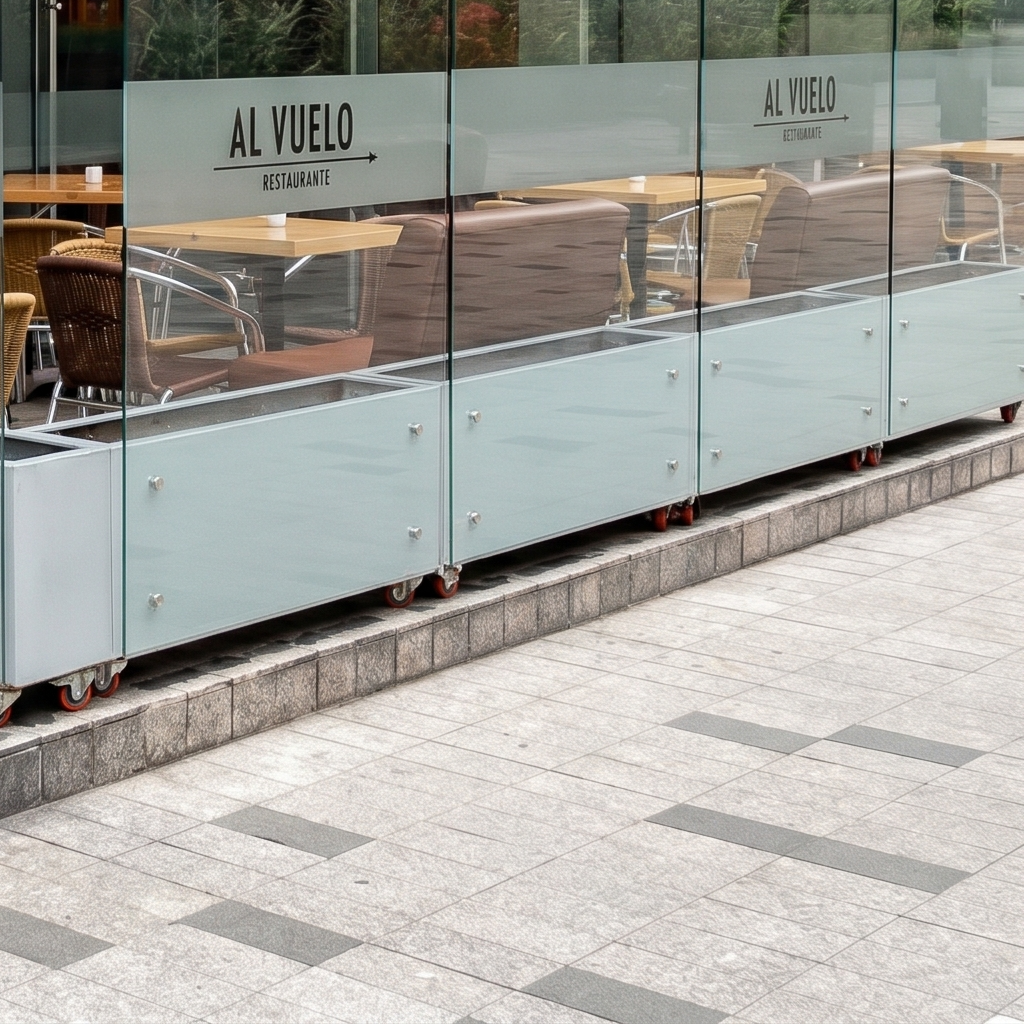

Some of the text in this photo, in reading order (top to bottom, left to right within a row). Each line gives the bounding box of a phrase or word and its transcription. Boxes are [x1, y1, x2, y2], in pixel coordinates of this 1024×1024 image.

[763, 75, 836, 117] AL VUELO
[229, 102, 353, 158] AL VUELO
[263, 169, 330, 191] RESTAURANTE
